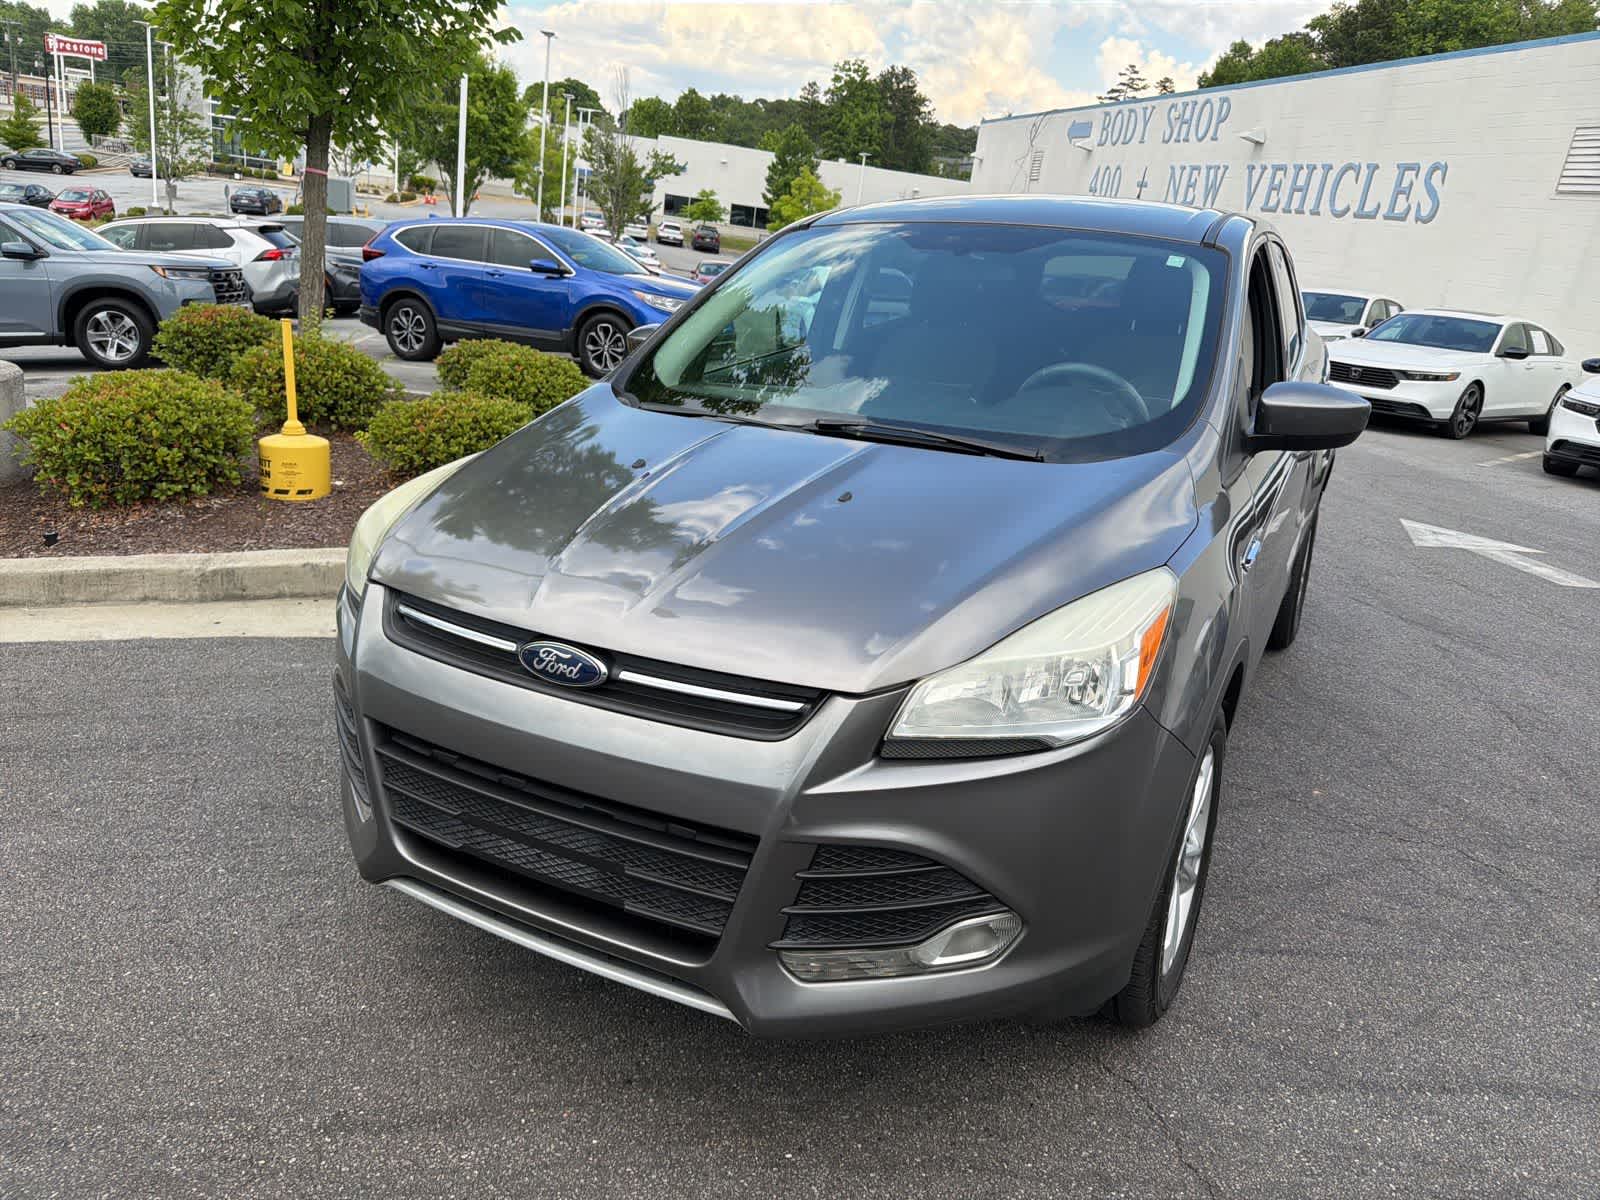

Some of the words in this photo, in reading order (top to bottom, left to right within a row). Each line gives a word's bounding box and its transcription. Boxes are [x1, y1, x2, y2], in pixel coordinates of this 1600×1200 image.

[1097, 105, 1155, 147] BODY
[1162, 96, 1232, 144] SHOP
[1089, 164, 1122, 197] 400
[1163, 164, 1230, 208] NEW
[1245, 161, 1449, 224] VEHICLES
[533, 647, 582, 679] Ford
